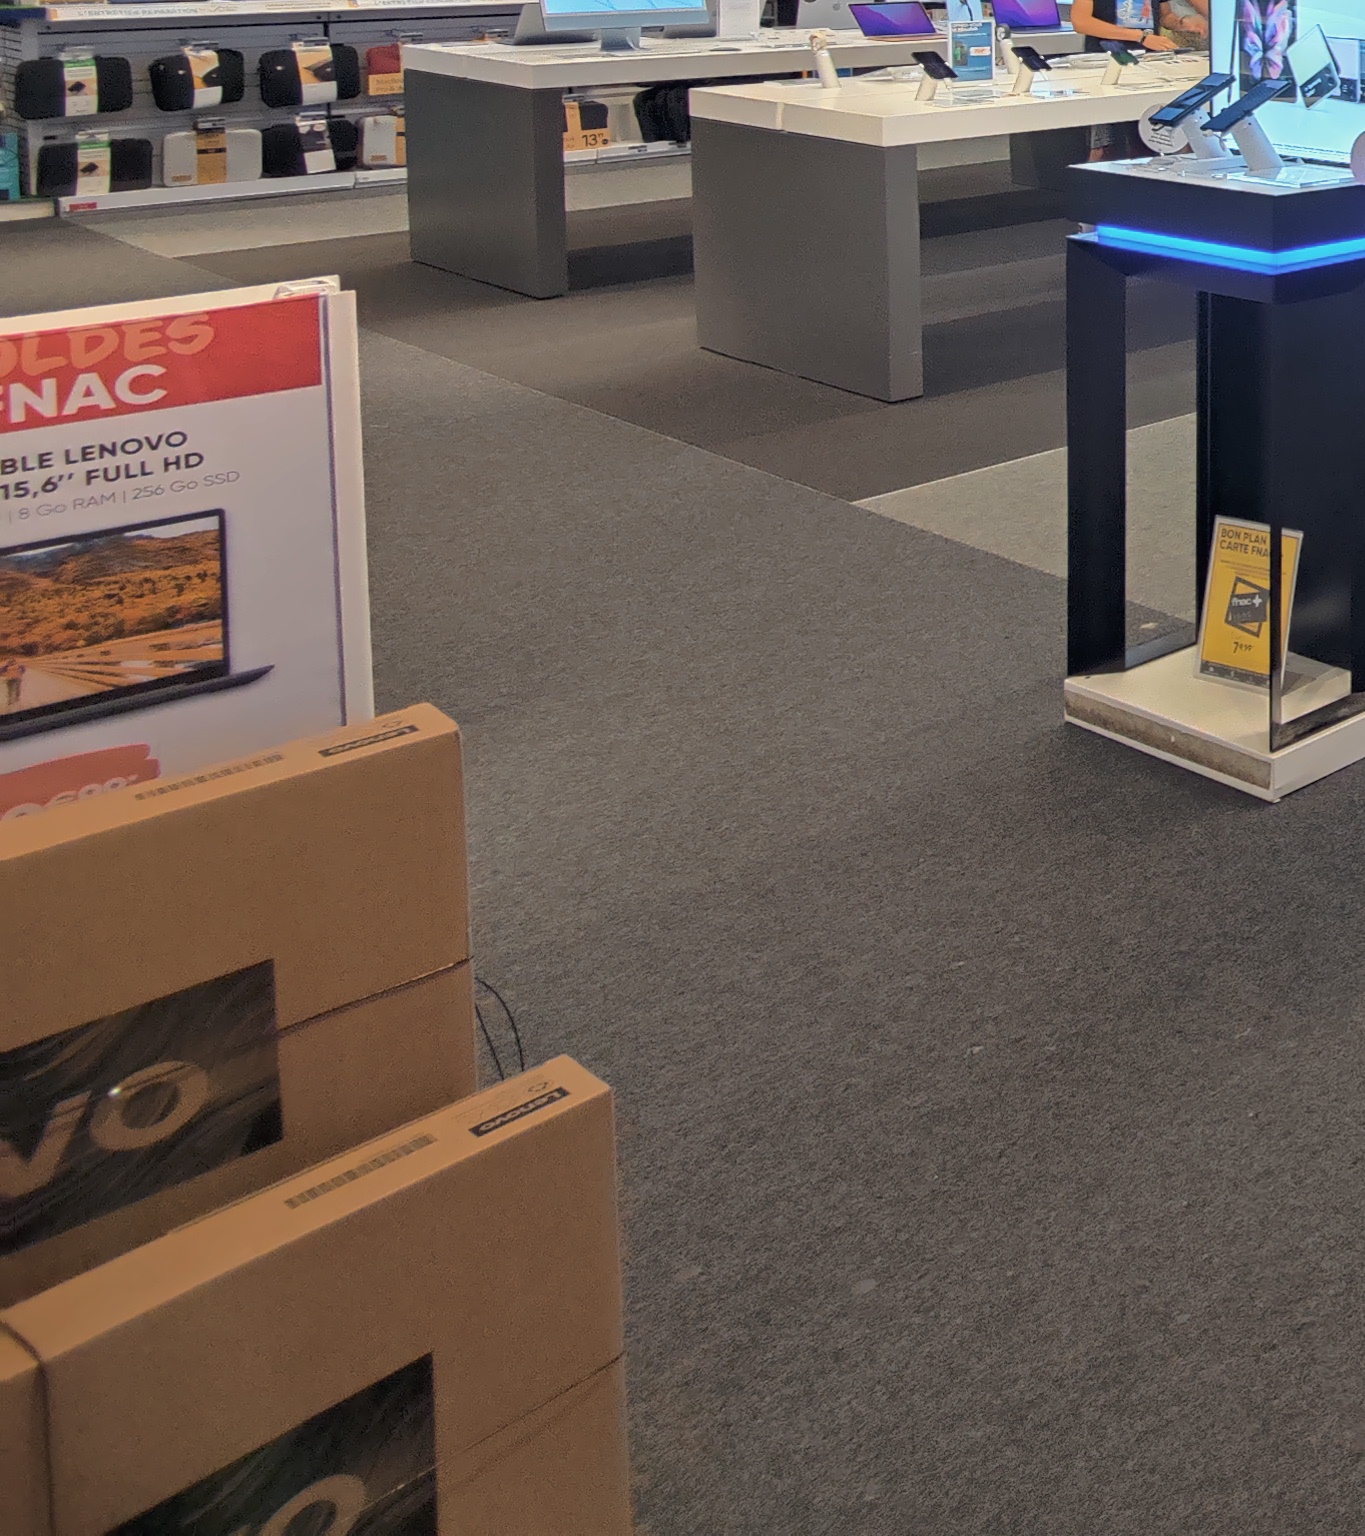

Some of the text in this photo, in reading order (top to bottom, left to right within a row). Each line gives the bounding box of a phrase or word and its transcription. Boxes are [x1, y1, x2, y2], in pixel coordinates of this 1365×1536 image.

[0, 313, 215, 378] LDES
[0, 431, 188, 475] BLE LENOVO
[85, 461, 153, 486] FULL
[163, 452, 204, 472] HD
[19, 470, 240, 520] 8 Go RAM 256 Go SSD
[1220, 528, 1267, 544] BON PLAN
[1220, 539, 1270, 558] CARTE FNA
